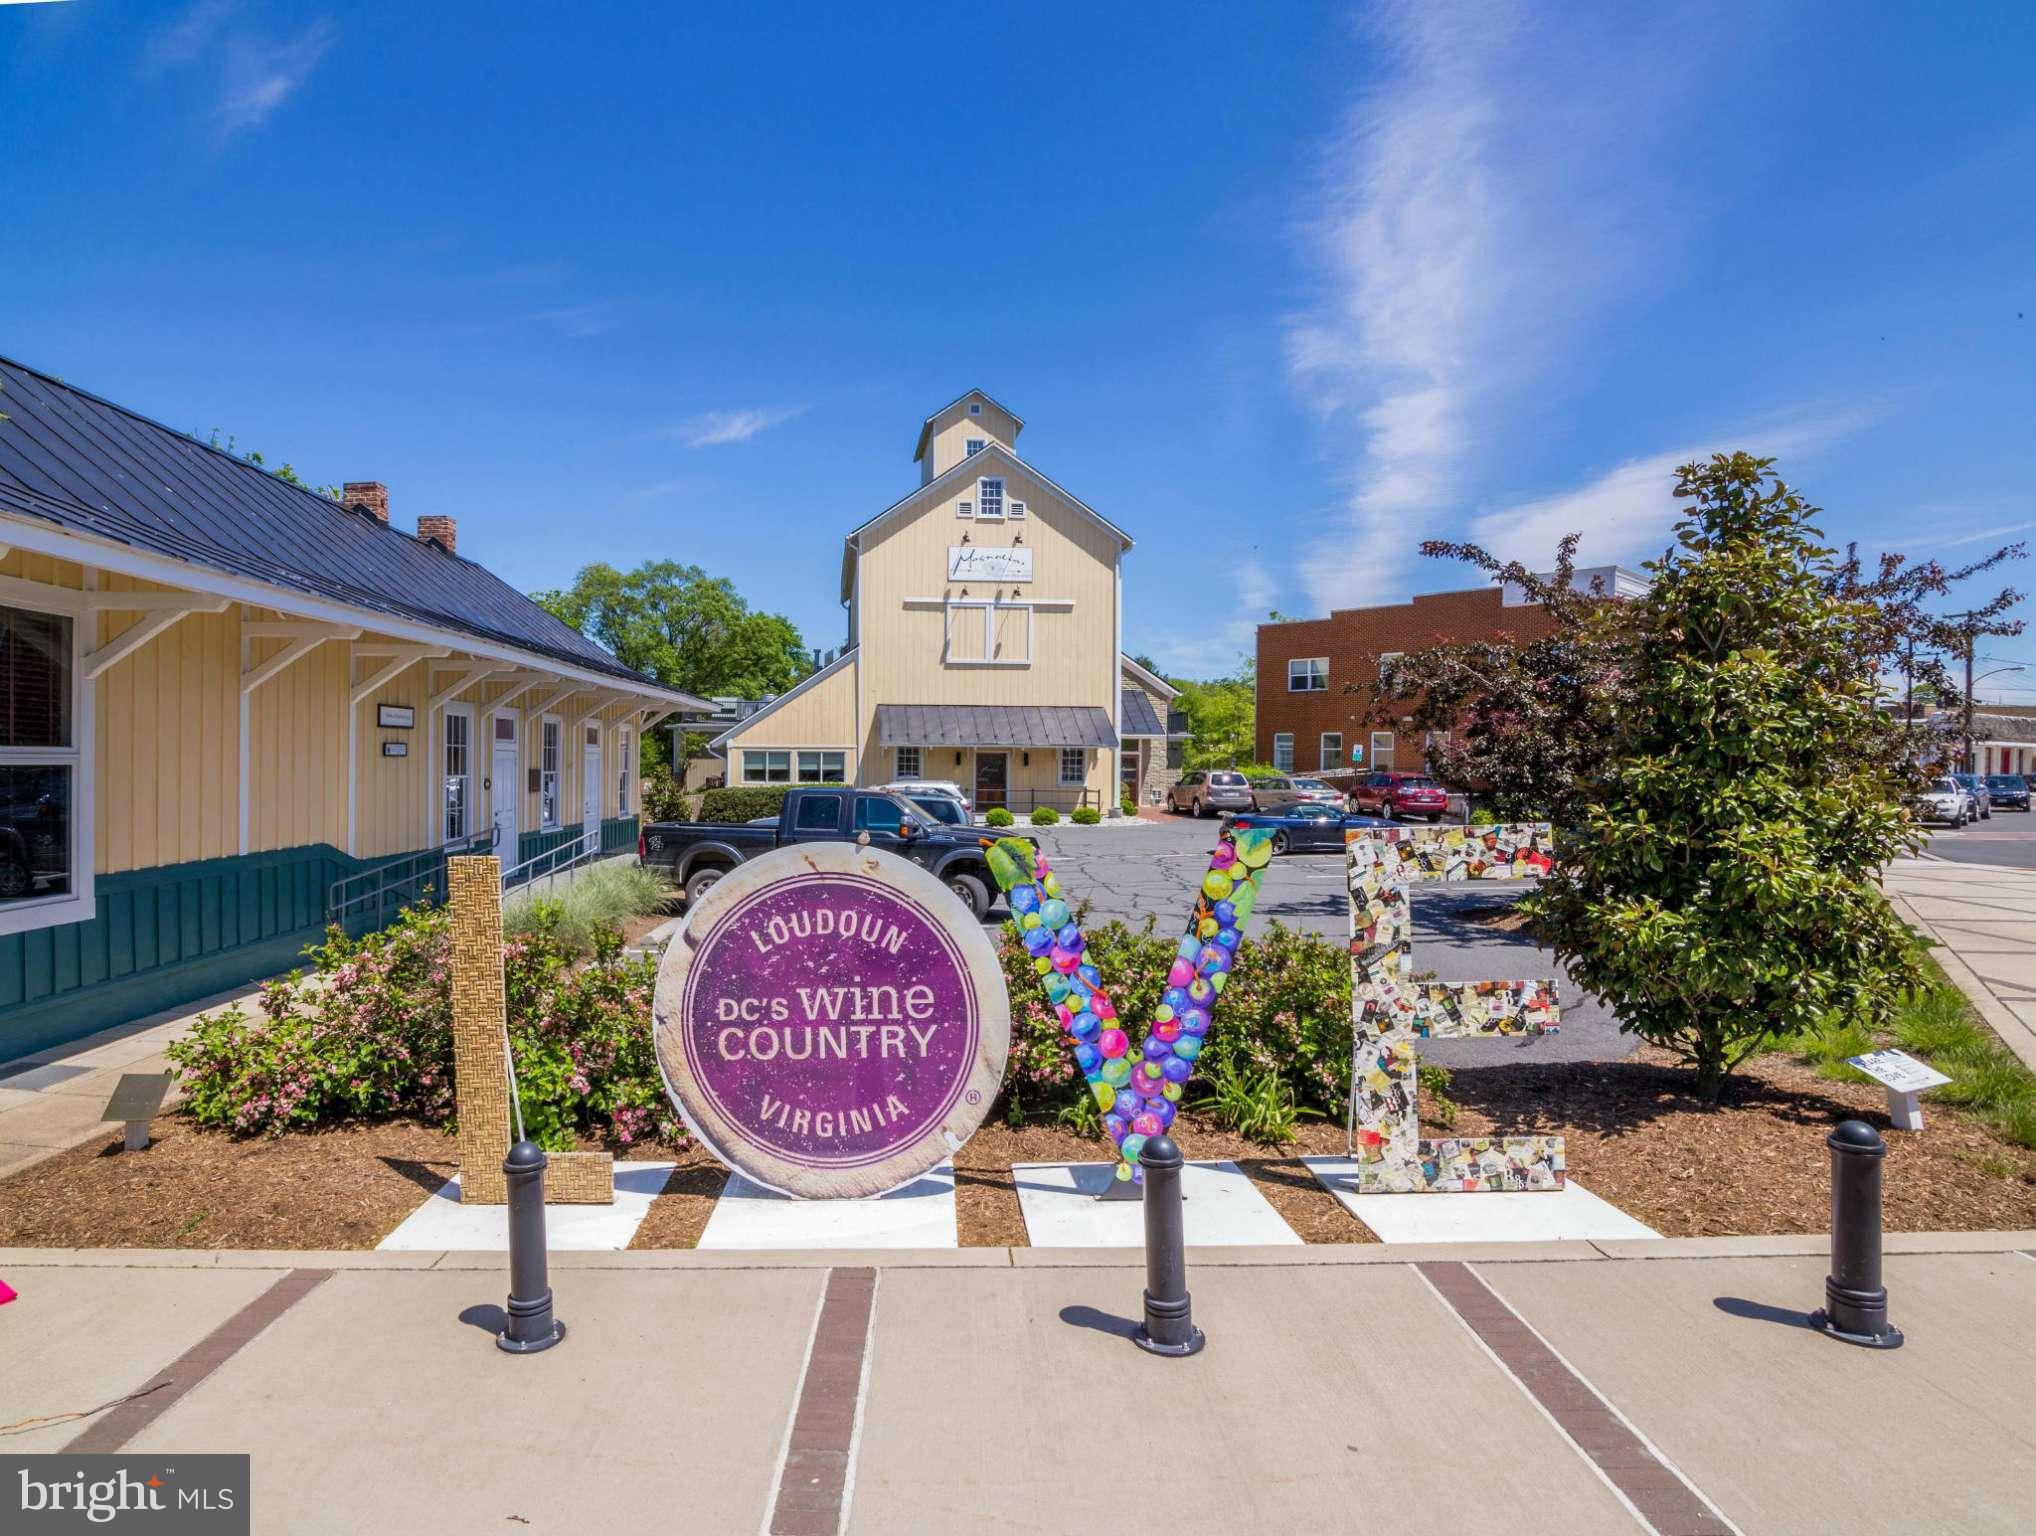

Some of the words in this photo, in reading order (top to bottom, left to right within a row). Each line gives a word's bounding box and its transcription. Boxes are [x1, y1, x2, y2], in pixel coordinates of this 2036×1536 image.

[750, 908, 908, 954] LOUDOUN
[718, 997, 790, 1021] DC'S
[718, 1024, 938, 1061] COUNTRY
[760, 1094, 910, 1138] VIRGINIA
